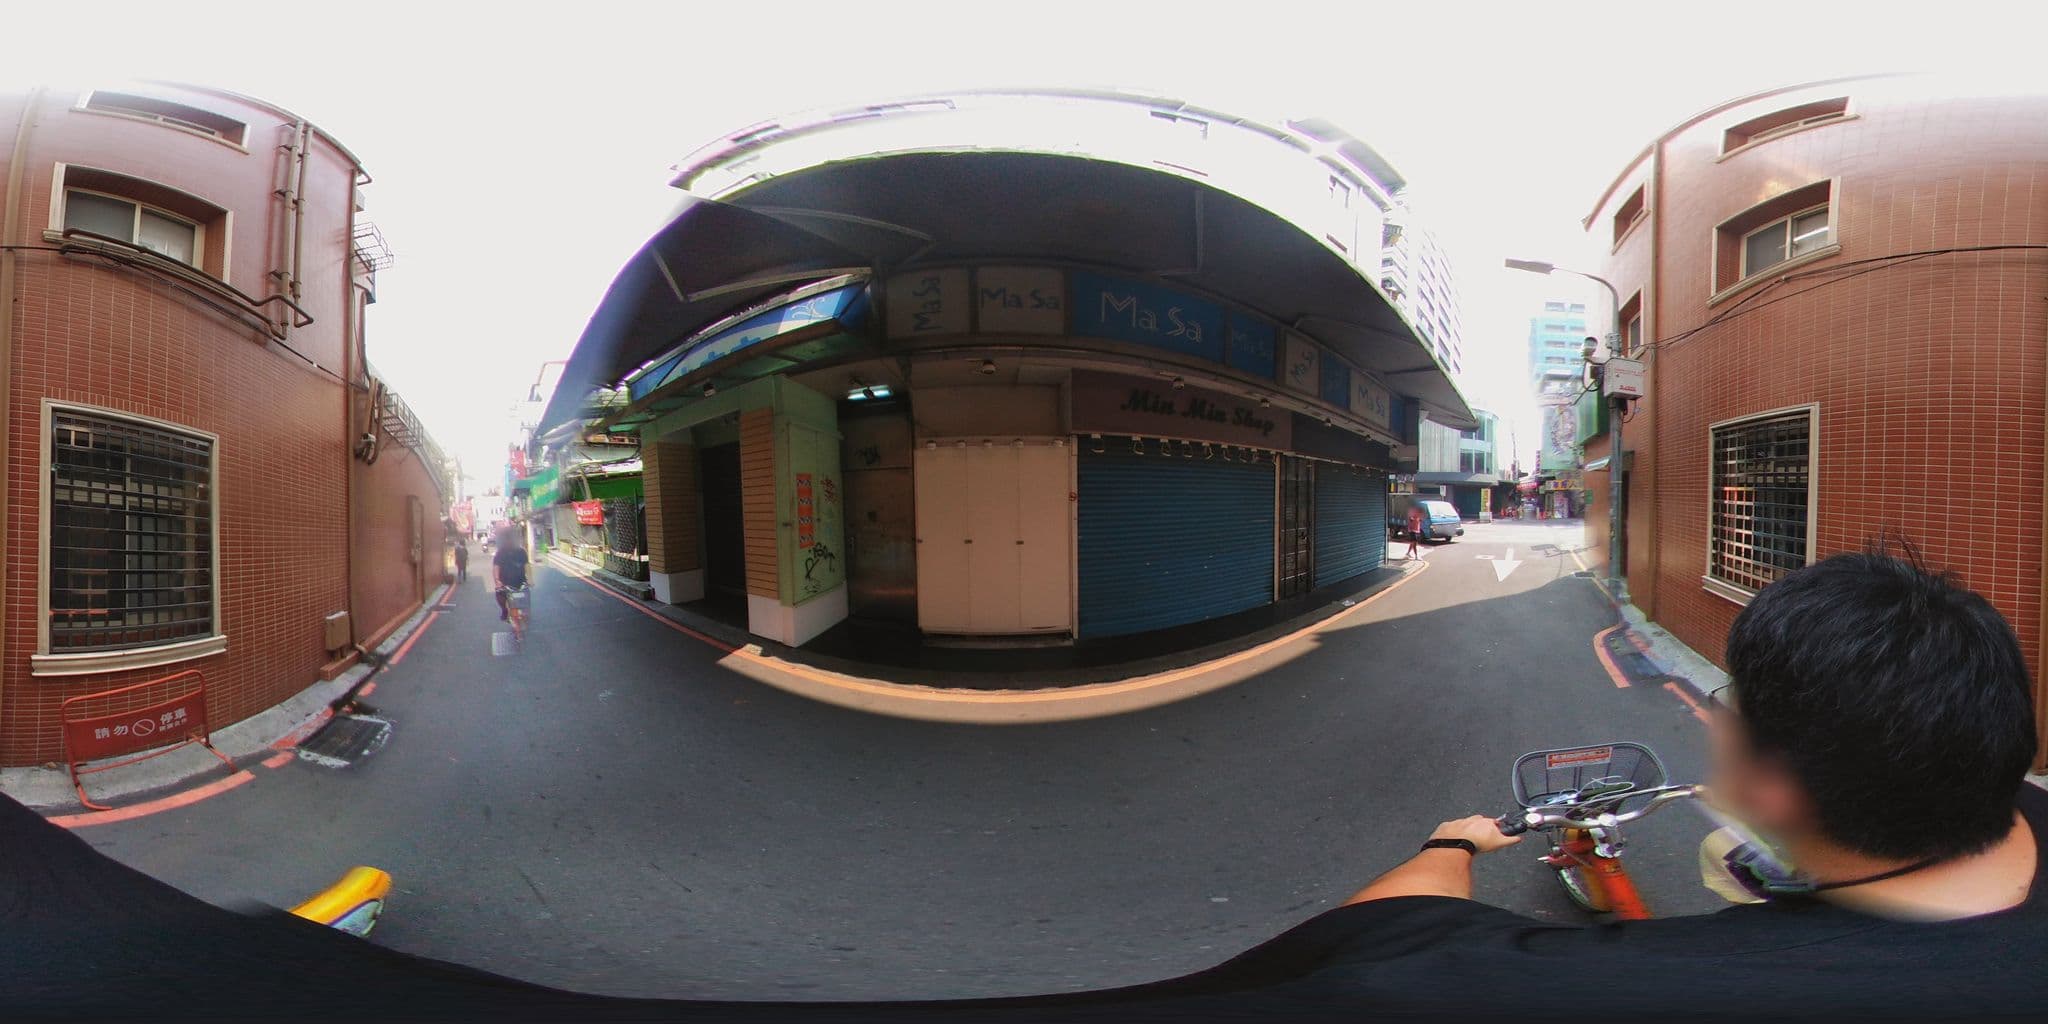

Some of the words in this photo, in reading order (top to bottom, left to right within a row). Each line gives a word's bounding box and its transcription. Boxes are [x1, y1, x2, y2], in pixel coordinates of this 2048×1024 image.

[981, 288, 1023, 308] Ma
[1030, 289, 1060, 310] Sa
[1100, 291, 1157, 330] Ma
[1167, 307, 1202, 342] Sa
[1120, 388, 1175, 415] Min
[1182, 398, 1227, 423] Min
[1232, 407, 1275, 437] Shop
[95, 725, 129, 739] 請勿
[160, 707, 187, 725] 停車
